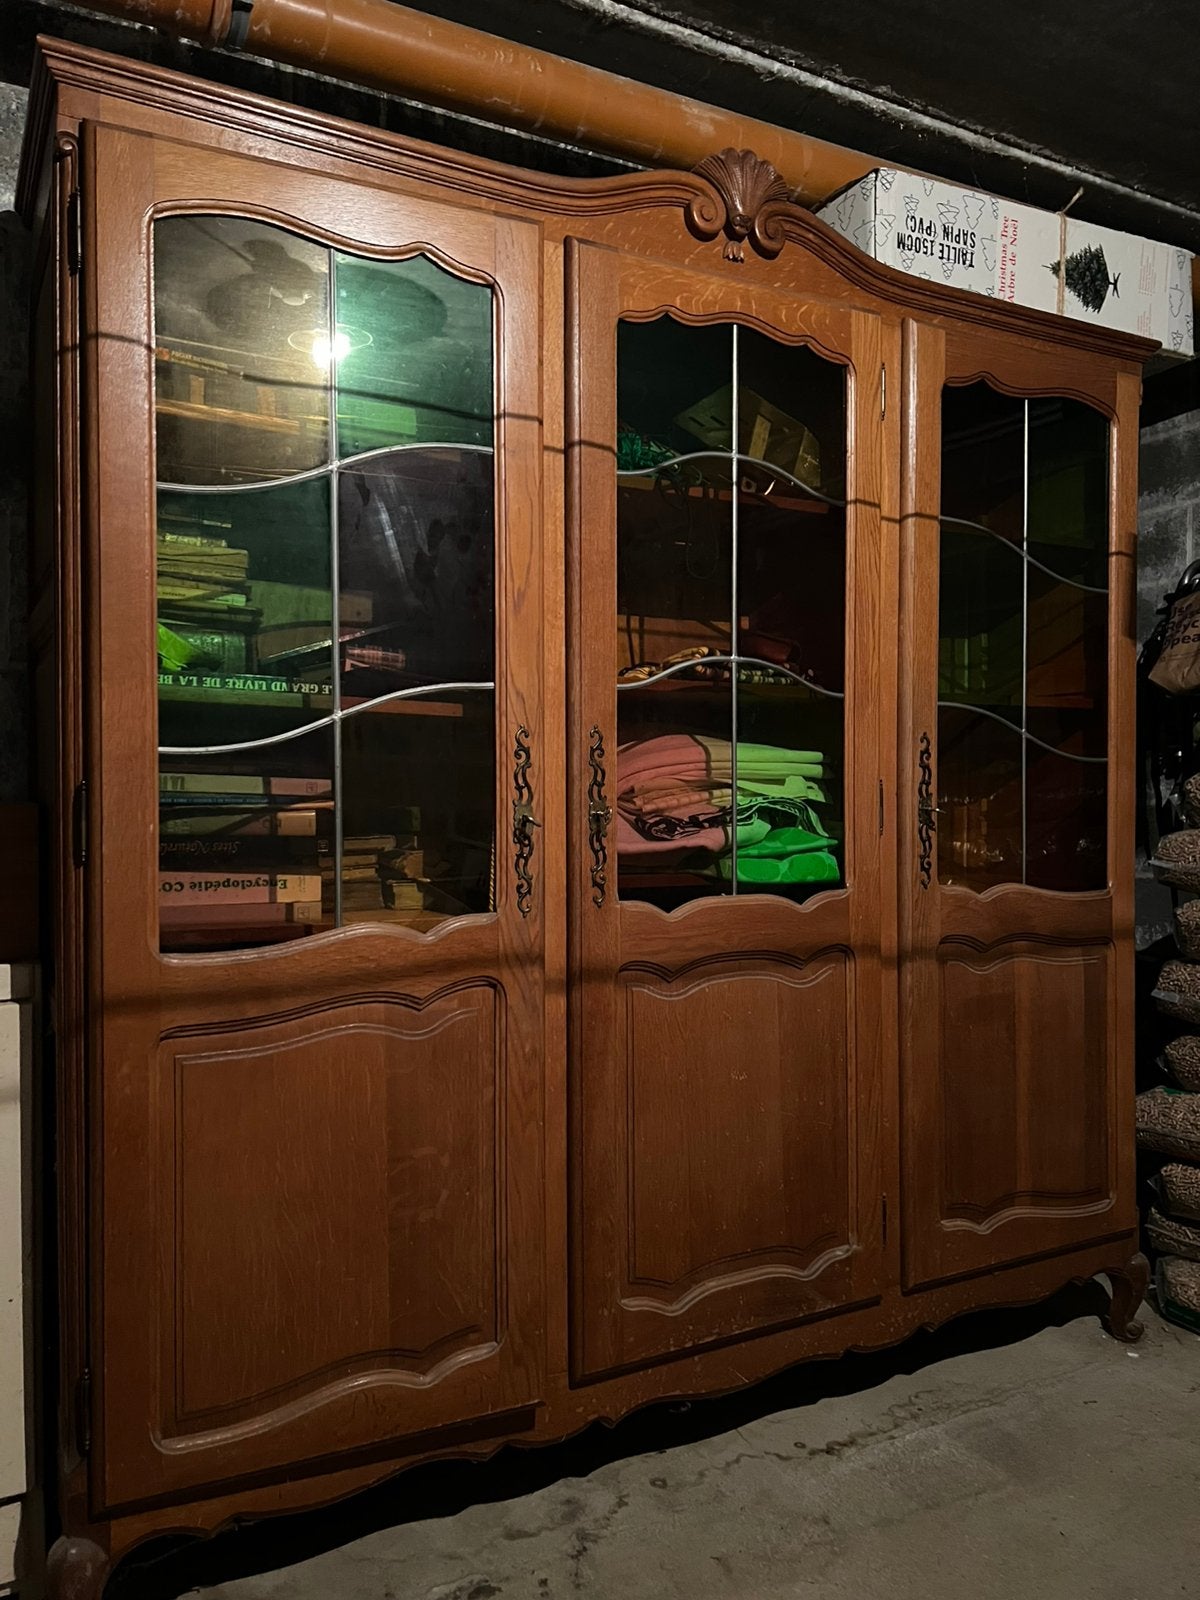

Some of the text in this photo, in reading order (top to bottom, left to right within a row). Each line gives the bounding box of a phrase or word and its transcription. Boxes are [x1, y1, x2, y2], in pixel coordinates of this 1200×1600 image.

[905, 214, 976, 249] SAPIN (PVC)
[1001, 215, 1010, 238] Tree
[897, 232, 975, 268] TAILLE 150CM
[1007, 218, 1019, 303] Arbre de Noël
[179, 674, 198, 687] LA
[202, 675, 222, 688] DE
[225, 676, 267, 691] LIVRE
[270, 680, 319, 695] GRAND
[159, 877, 288, 892] Encyclopédie CO
